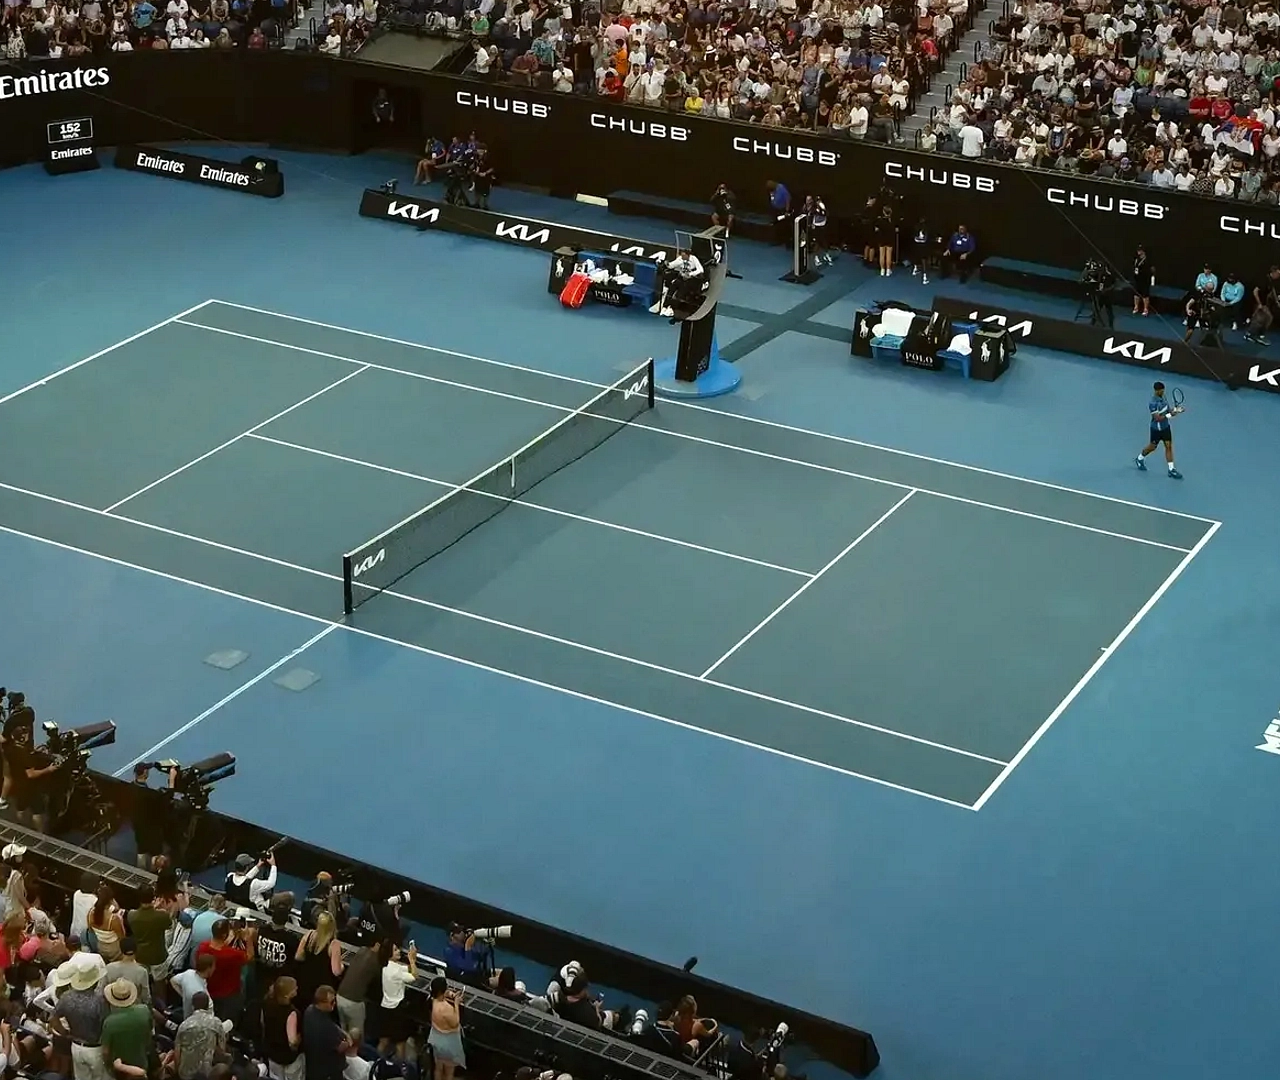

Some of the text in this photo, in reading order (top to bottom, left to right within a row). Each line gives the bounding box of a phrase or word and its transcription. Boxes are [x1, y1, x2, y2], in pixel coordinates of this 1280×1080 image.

[455, 90, 548, 118] CHUBB
[59, 123, 81, 135] 152
[590, 113, 687, 141] CHUBB
[51, 146, 93, 160] Emirates
[732, 137, 837, 166] CHUBB
[136, 152, 185, 174] Emirates
[199, 164, 250, 186] Emirates
[884, 162, 995, 192] CHUBB
[1046, 186, 1165, 220] CHUBB
[594, 289, 620, 302] POLO
[905, 351, 934, 364] POLO
